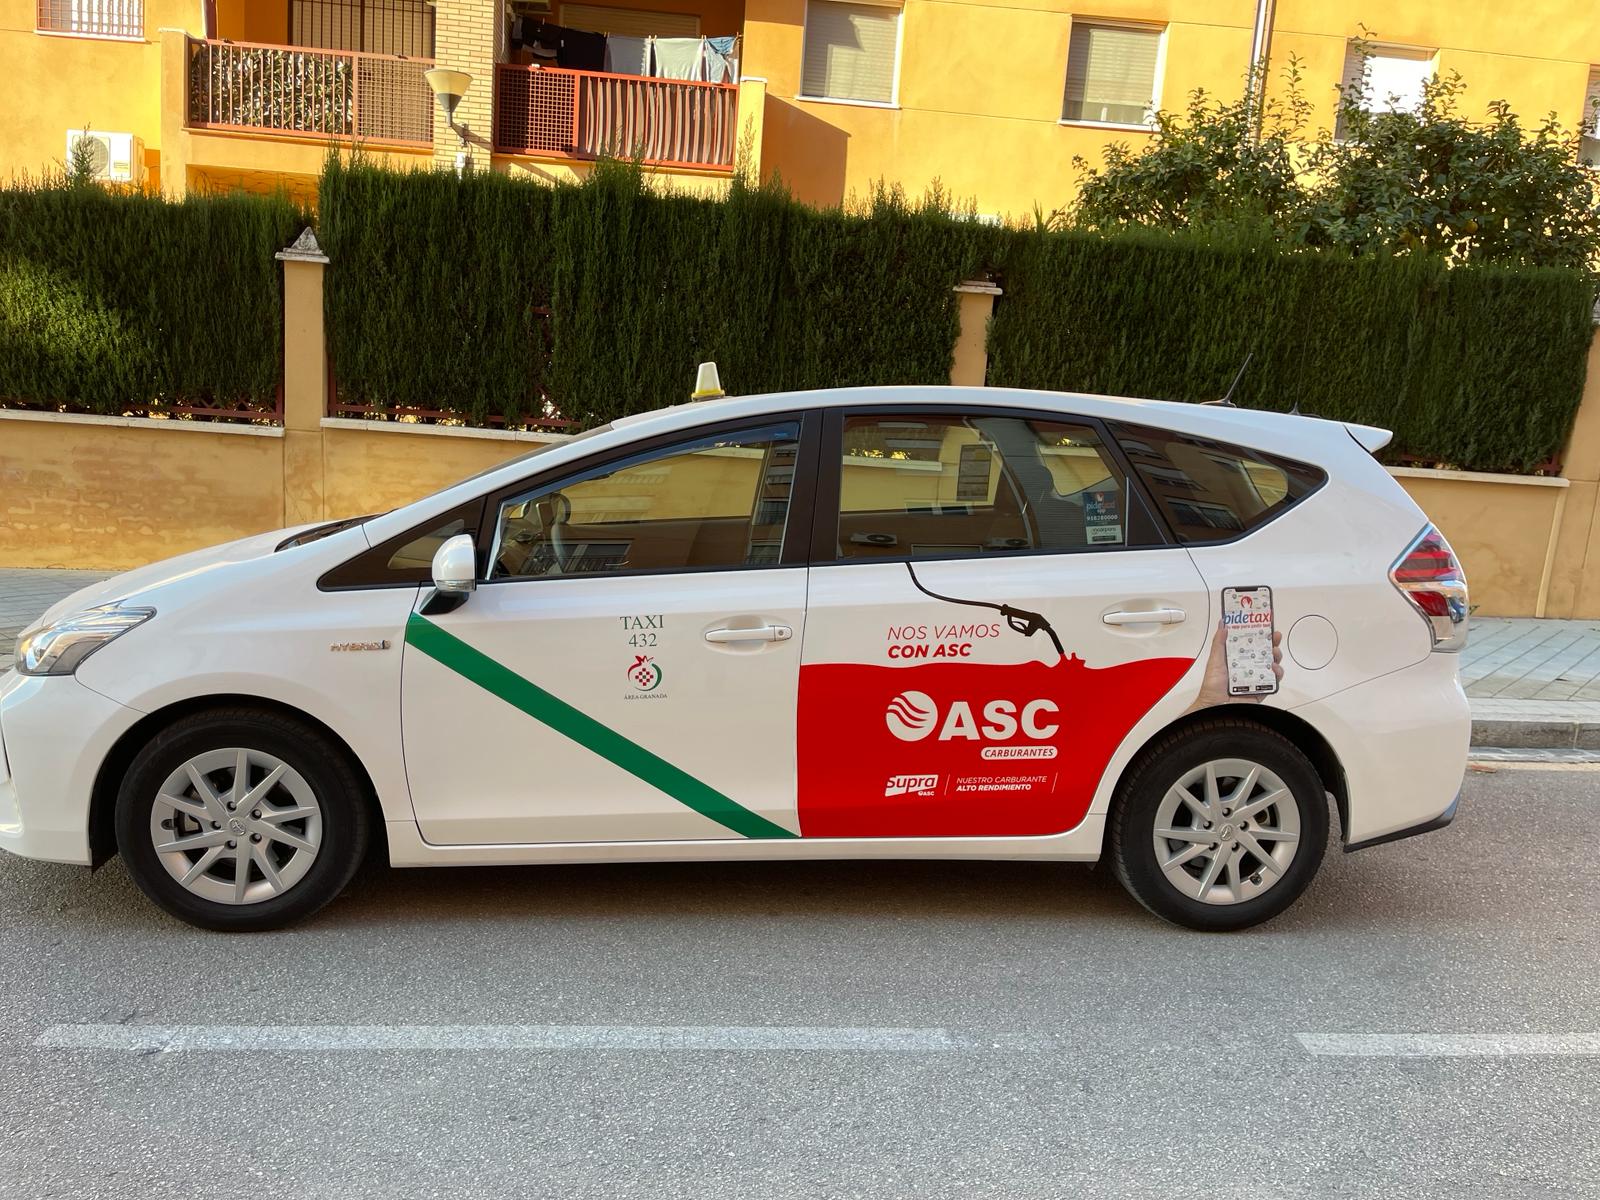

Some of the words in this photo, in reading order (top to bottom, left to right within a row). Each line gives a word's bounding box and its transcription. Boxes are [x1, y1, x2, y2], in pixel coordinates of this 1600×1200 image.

[620, 615, 664, 630] TAXI
[887, 625, 927, 641] NOS
[934, 623, 1001, 639] VAMOS
[628, 633, 657, 647] 432
[887, 645, 929, 659] CON
[932, 643, 973, 658] ASC
[938, 699, 1060, 741] ASC
[984, 748, 1054, 758] CARBURANTES
